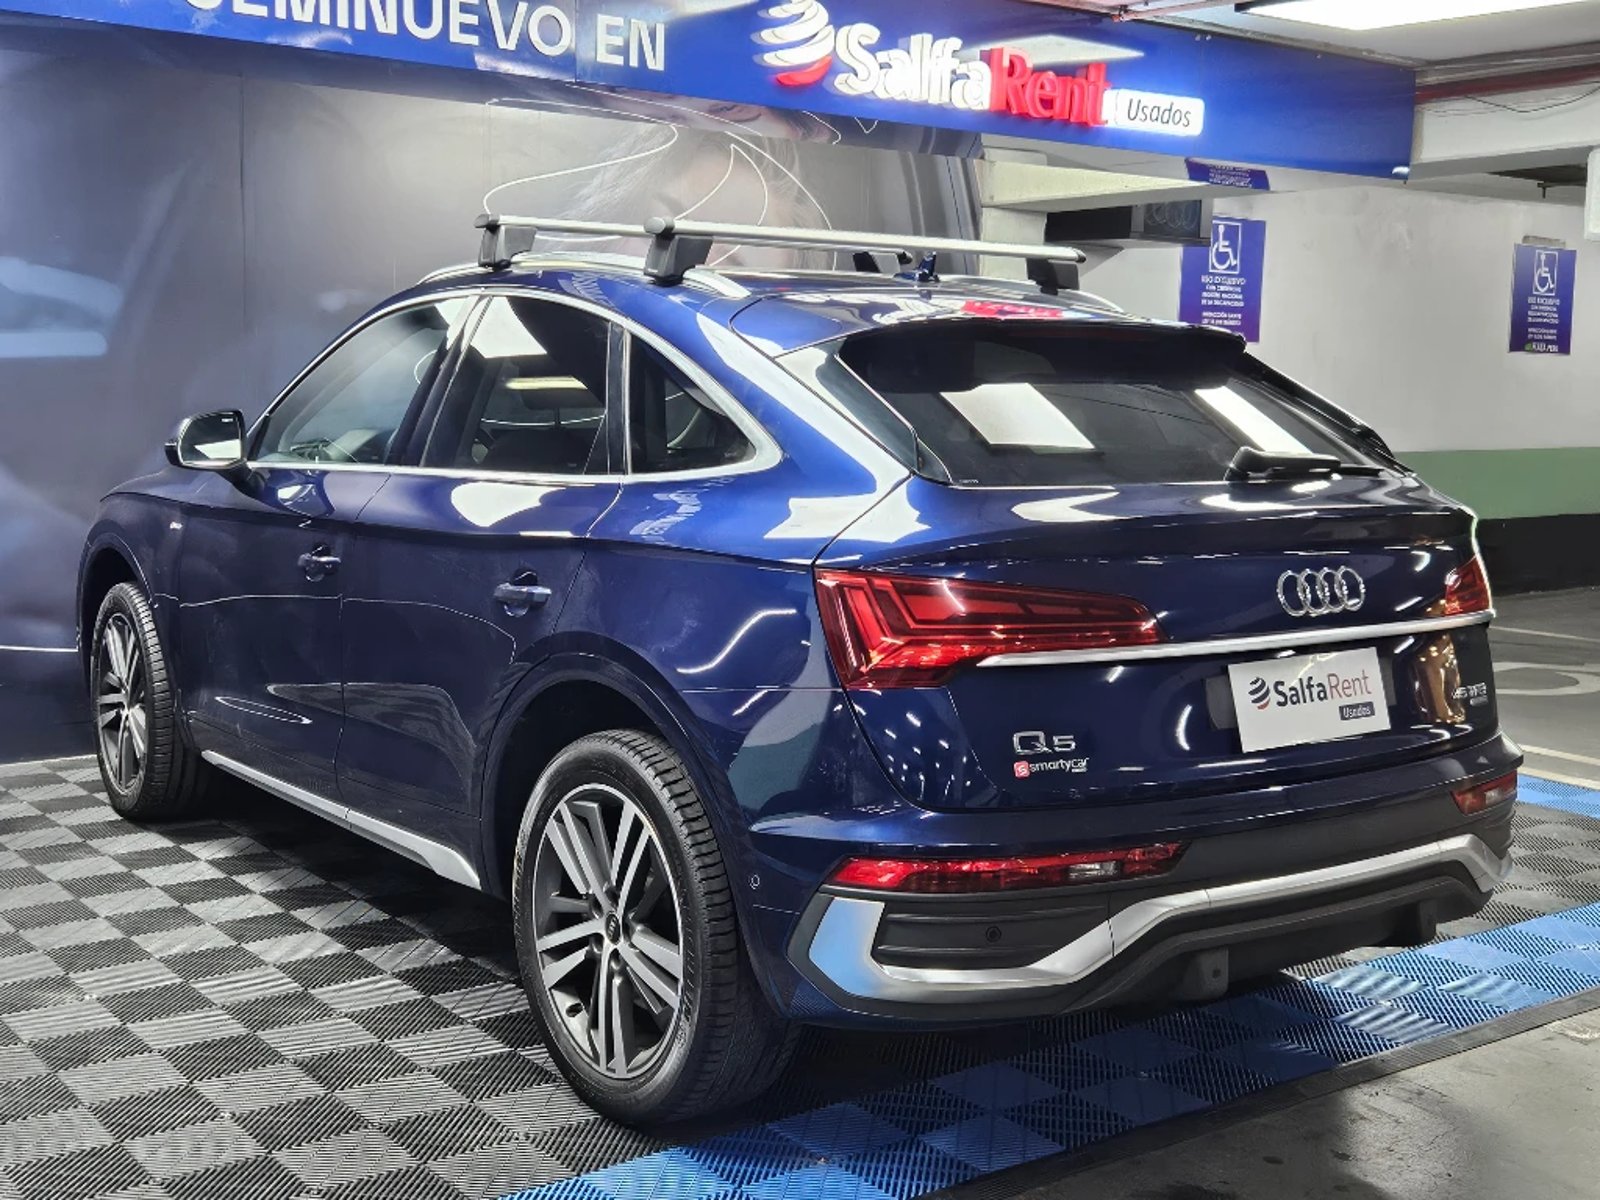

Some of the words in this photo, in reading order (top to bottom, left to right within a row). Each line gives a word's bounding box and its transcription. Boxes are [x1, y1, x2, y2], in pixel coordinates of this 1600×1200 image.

[595, 13, 665, 71] EN
[834, 22, 1111, 127] SalfaRent
[1126, 98, 1192, 128] Usados
[1273, 669, 1372, 707] SalfaRent
[1343, 706, 1371, 718] Usados
[1013, 730, 1076, 755] Q5
[1029, 757, 1090, 773] smartycar
